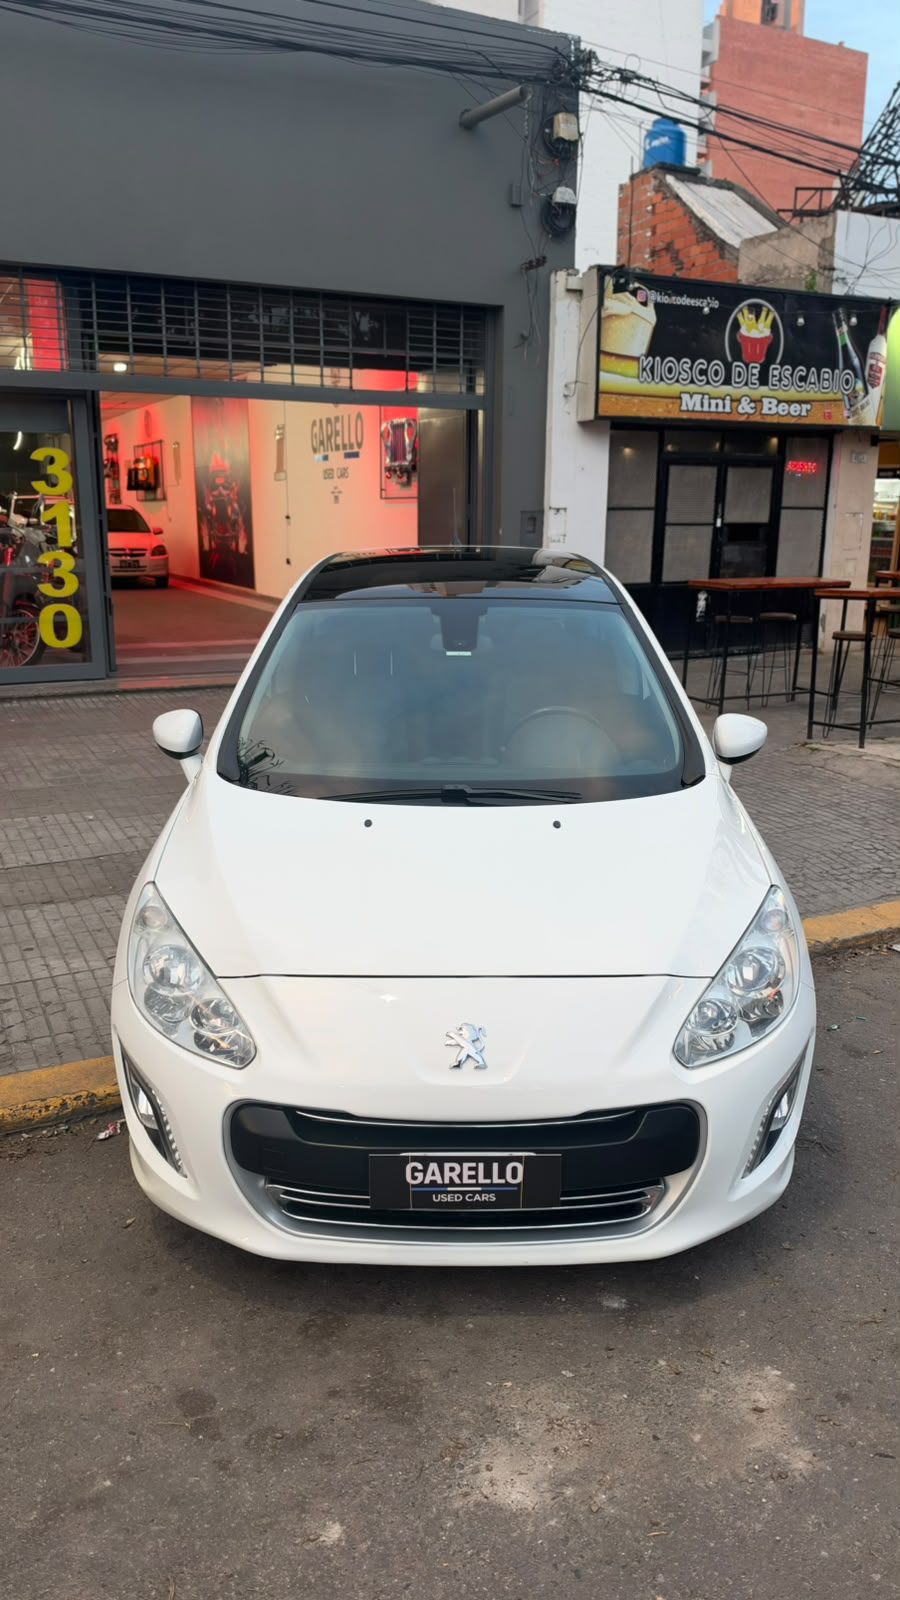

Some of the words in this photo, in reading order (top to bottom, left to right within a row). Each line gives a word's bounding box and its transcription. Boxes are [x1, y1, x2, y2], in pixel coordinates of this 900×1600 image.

[638, 355, 726, 387] KIOSCO
[731, 361, 760, 388] DE
[768, 364, 855, 394] ESCABIO
[680, 392, 732, 414] Mini
[737, 395, 755, 414] &
[761, 396, 813, 418] Beer
[311, 411, 364, 454] GARELLO
[405, 1162, 523, 1184] GARELLO
[432, 1194, 462, 1202] USED
[465, 1193, 496, 1202] CARS
